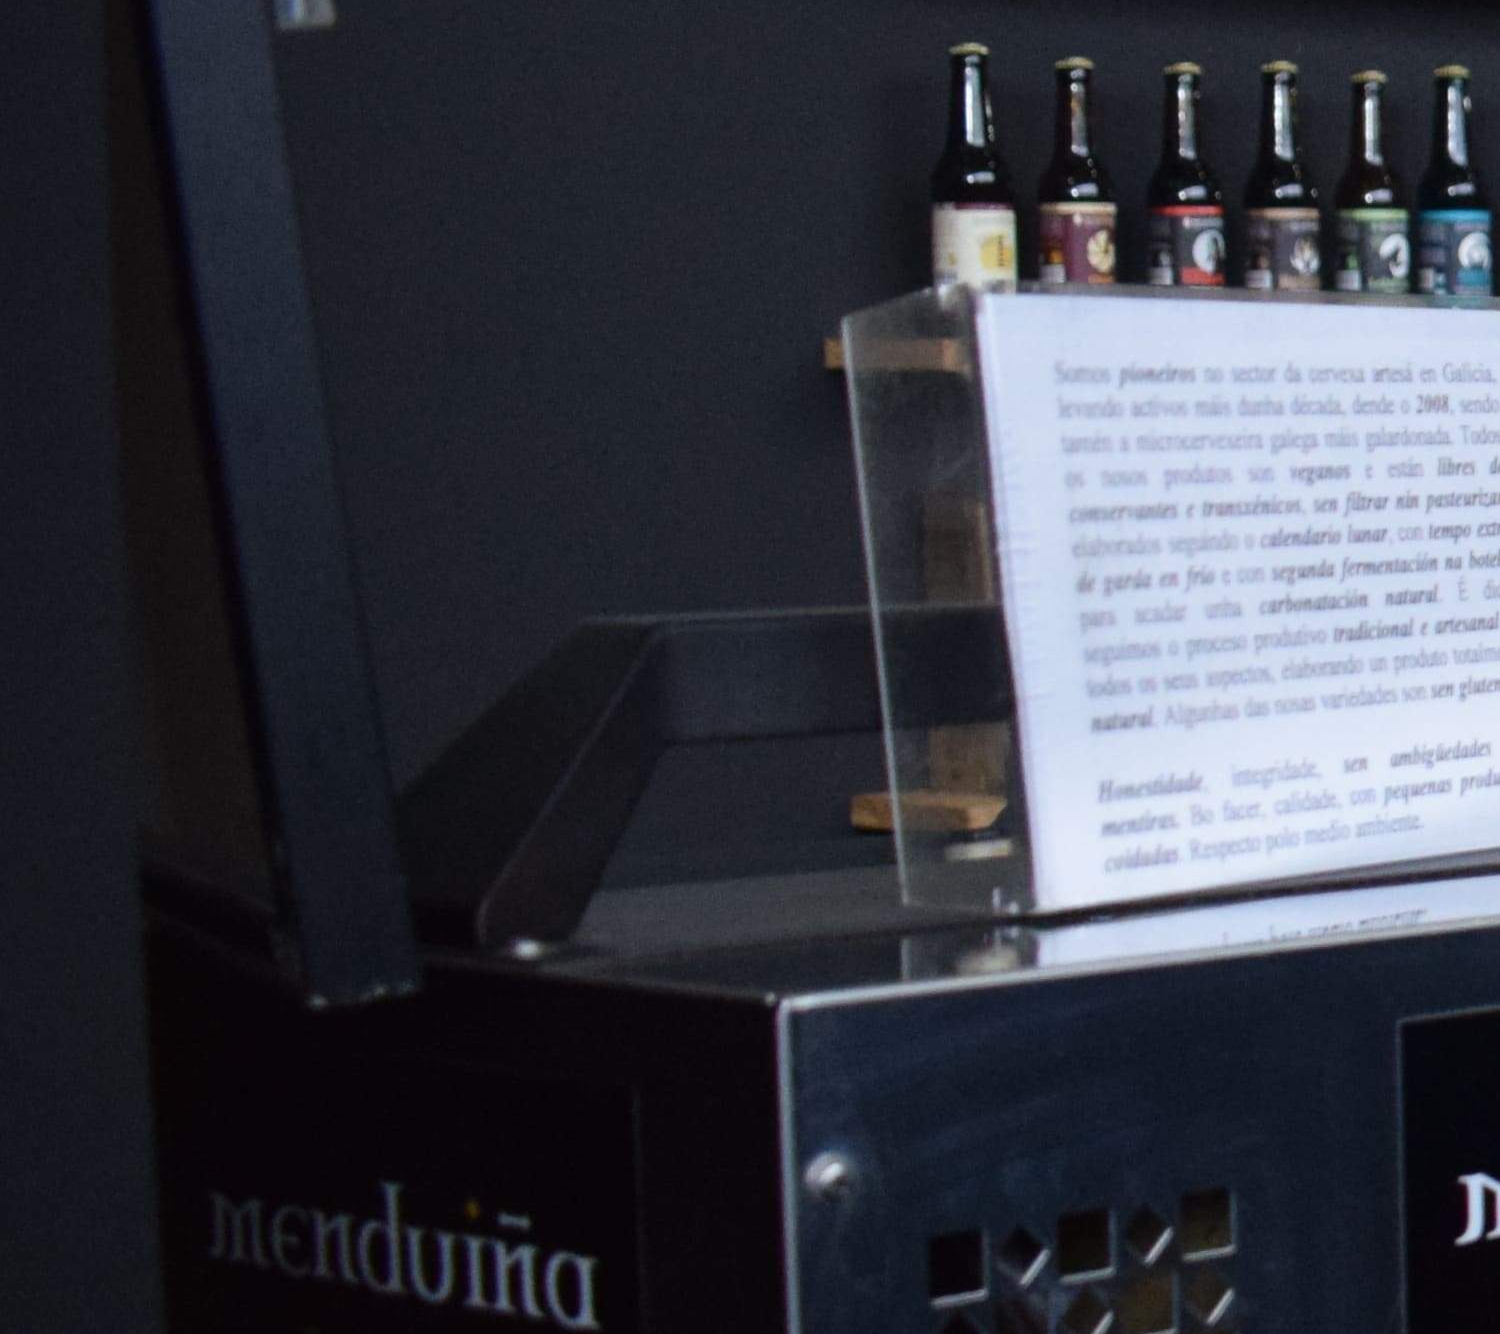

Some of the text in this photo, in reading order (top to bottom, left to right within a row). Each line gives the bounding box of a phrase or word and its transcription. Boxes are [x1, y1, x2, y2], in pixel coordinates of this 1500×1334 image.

[1309, 367, 1365, 384] cervexa
[1371, 362, 1413, 384] artesá
[1418, 368, 1437, 384] en
[1441, 362, 1496, 386] Galicia,
[1289, 394, 1345, 419] década,
[1351, 394, 1394, 416] dende
[1399, 399, 1410, 415] o
[1459, 393, 1500, 415] sendo
[1322, 426, 1359, 448] máis
[1289, 464, 1351, 486] veganos
[1363, 463, 1373, 479] e
[1386, 457, 1422, 477] están
[1435, 456, 1475, 476] libres
[1312, 496, 1340, 513] sen
[1344, 489, 1390, 516] filtrar
[1393, 489, 1421, 510] nin
[1396, 524, 1423, 541] con
[1426, 520, 1472, 544] tempo
[1270, 557, 1336, 585] segunda
[1340, 552, 1439, 580] fermentación
[1442, 554, 1464, 571] na
[1257, 587, 1368, 613] carbonatación
[1383, 583, 1442, 604] natural.
[1456, 575, 1470, 601] É
[1331, 617, 1414, 641] tradicional
[1418, 620, 1429, 636] e
[1432, 611, 1500, 633] artesanal
[1281, 654, 1363, 679] elaborando
[1368, 655, 1388, 673] un
[1392, 647, 1448, 674] produto
[1320, 684, 1397, 708] variedades
[1400, 684, 1427, 703] son
[1429, 682, 1456, 700] sen
[1342, 755, 1369, 774] sen
[1388, 738, 1492, 772] ambigüedades
[1273, 789, 1340, 816] calidade,
[1349, 787, 1377, 807] con
[1383, 780, 1453, 805] pequenas
[1304, 820, 1347, 843] medio
[1354, 810, 1424, 836] ambiente.
